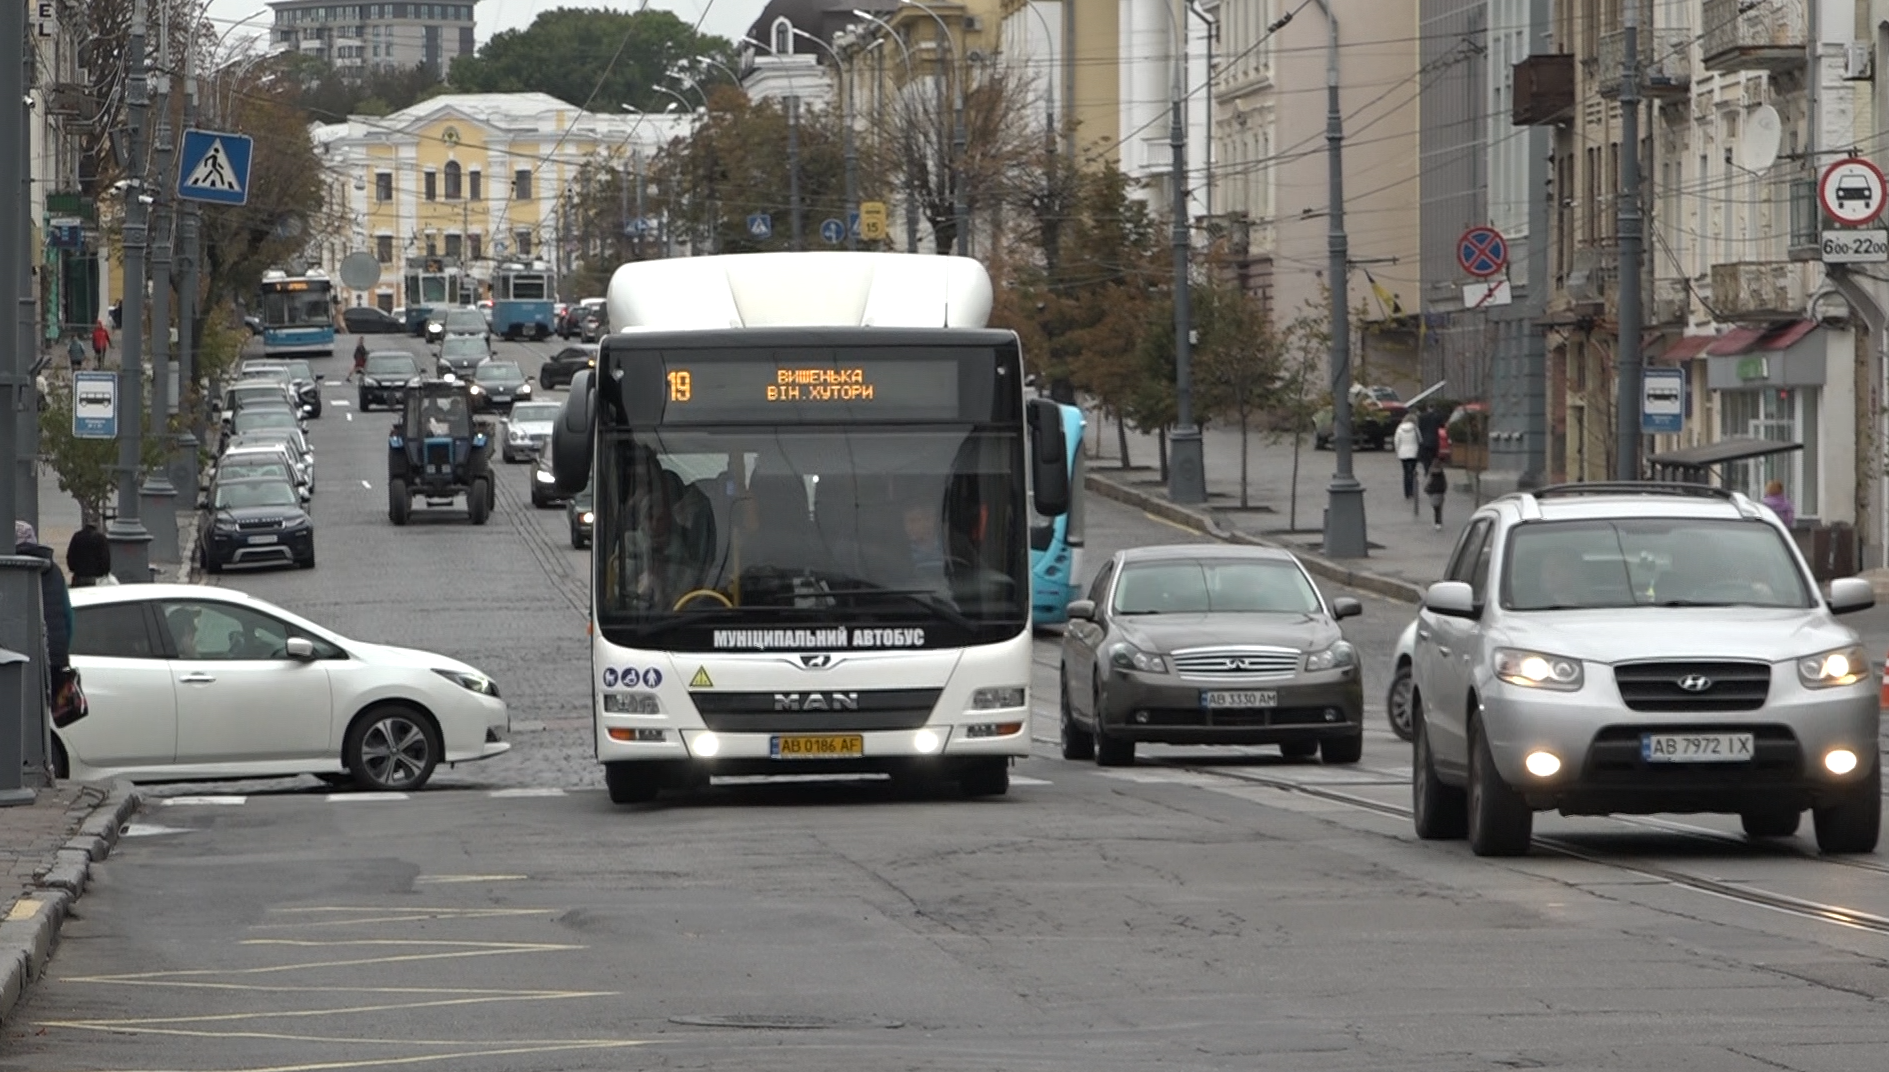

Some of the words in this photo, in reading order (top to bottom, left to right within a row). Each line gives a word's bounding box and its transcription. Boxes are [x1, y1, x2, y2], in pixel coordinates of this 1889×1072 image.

[866, 222, 879, 233] 15
[777, 369, 863, 384] ВИШЕНЬКА
[667, 370, 692, 401] 19
[713, 626, 848, 650] МУНІЦИПАЛЬНИЙ
[852, 628, 925, 646] АВТОБУС
[773, 692, 859, 711] MAN
[1209, 693, 1226, 705] AB
[1259, 693, 1276, 705] AM
[781, 738, 801, 753] AB
[804, 738, 837, 754] 0186
[840, 738, 859, 753] AF
[1653, 738, 1677, 755] AB
[1681, 737, 1721, 754] 7972
